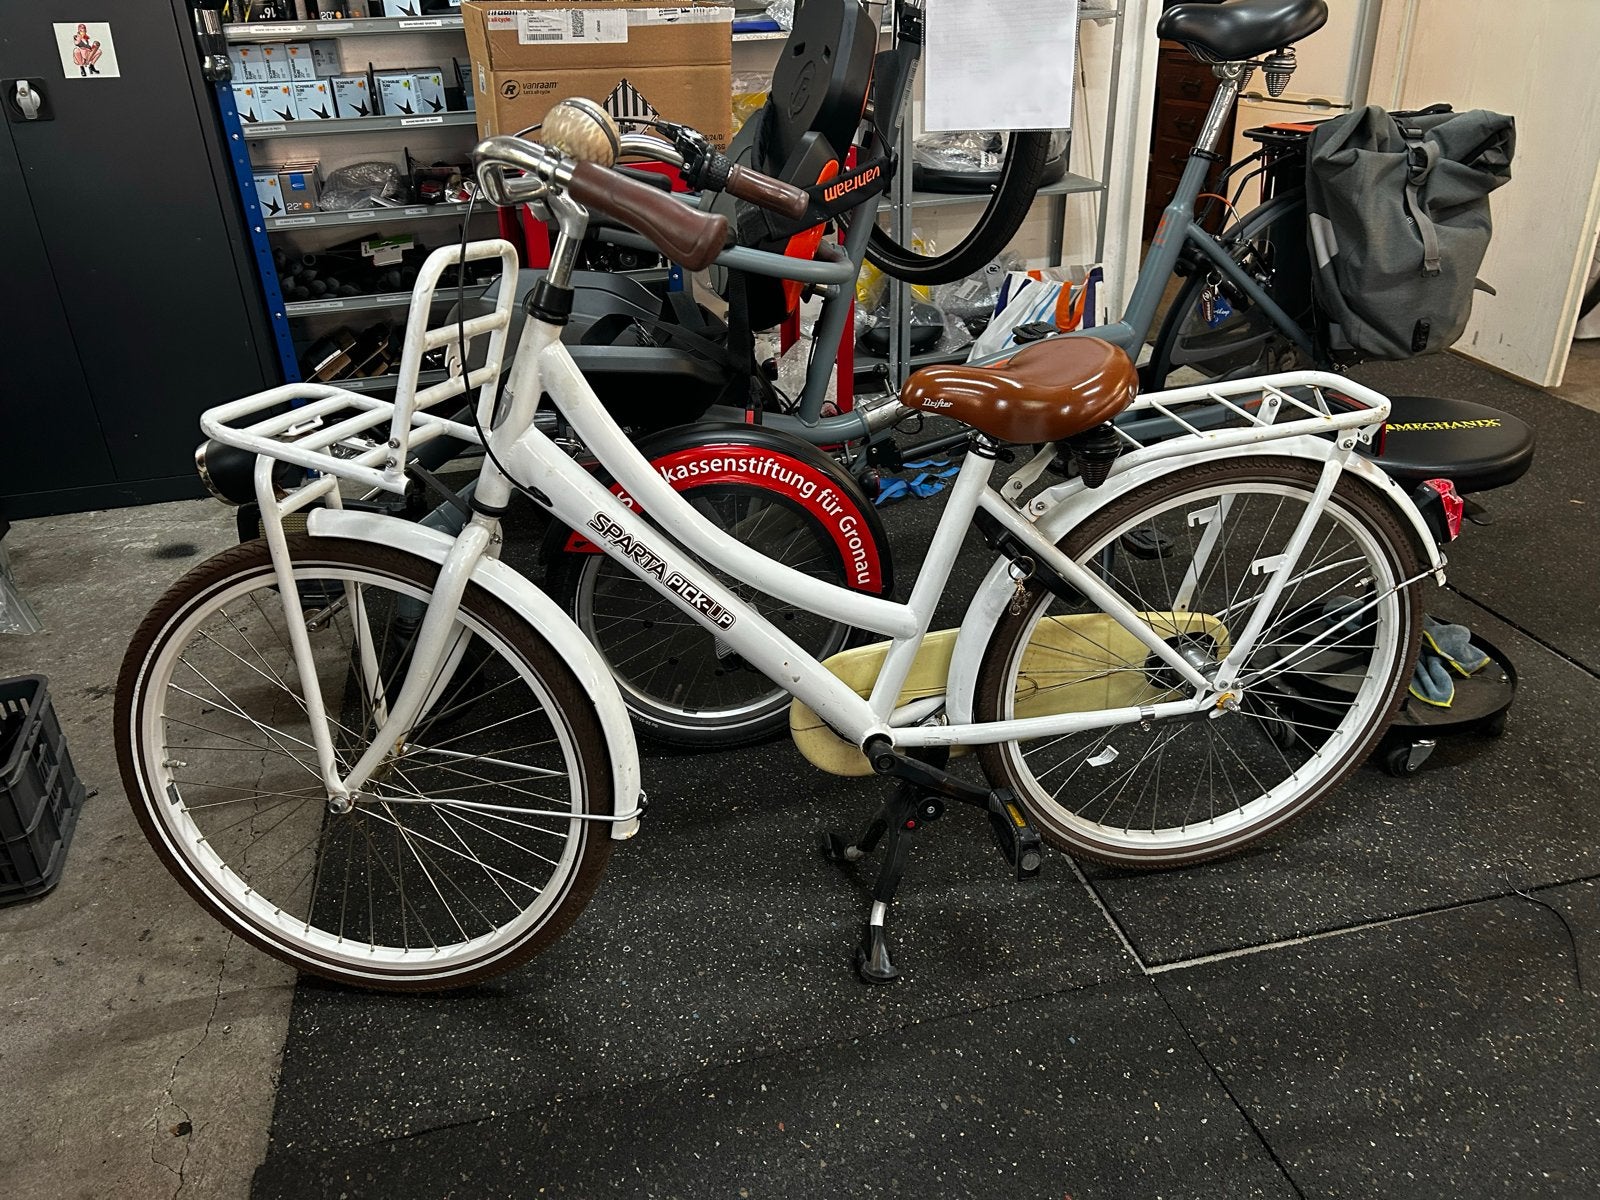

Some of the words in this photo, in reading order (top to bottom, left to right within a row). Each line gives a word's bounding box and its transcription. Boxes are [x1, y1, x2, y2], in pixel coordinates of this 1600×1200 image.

[522, 81, 557, 90] vanraam
[824, 165, 880, 202] vanraam
[286, 202, 302, 211] 22"
[922, 398, 954, 409] Drifter
[816, 489, 843, 516] für
[839, 516, 870, 584] Gronau
[587, 511, 667, 583] SPARTA
[665, 572, 735, 630] PICK-UP
